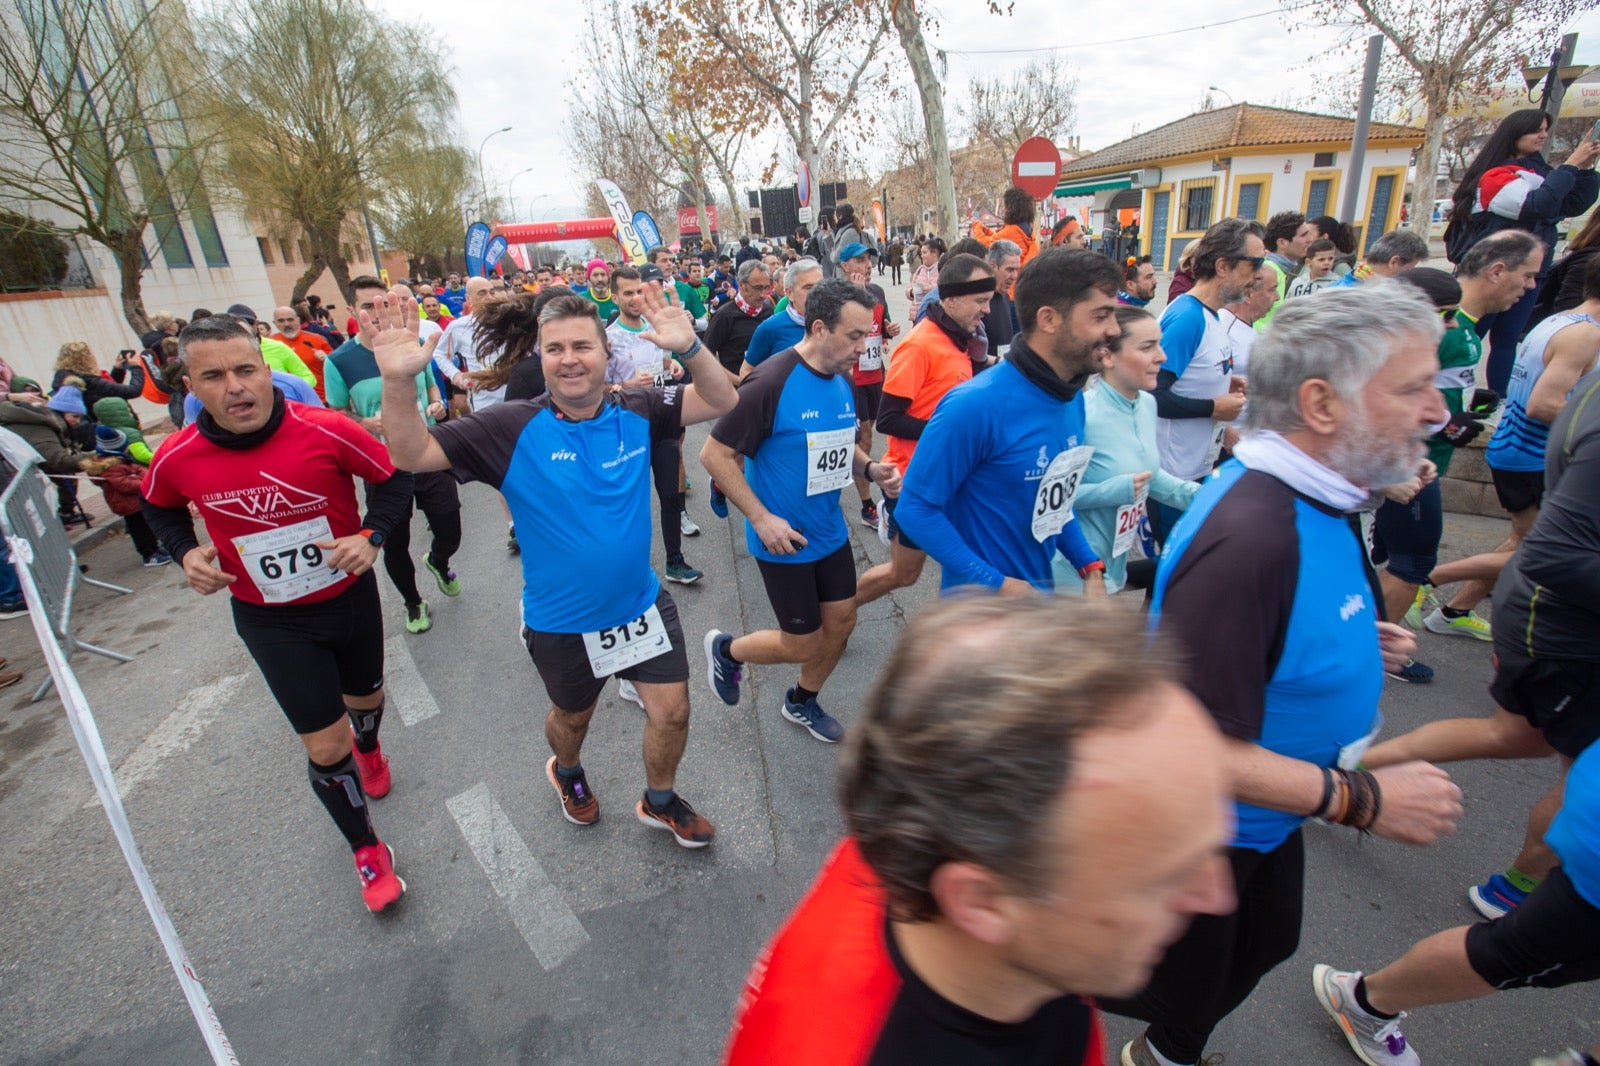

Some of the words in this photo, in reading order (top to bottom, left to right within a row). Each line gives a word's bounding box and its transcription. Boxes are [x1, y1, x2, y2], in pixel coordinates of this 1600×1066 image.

[817, 447, 848, 472] 492
[202, 492, 223, 501] CLUB
[224, 485, 279, 499] DEPORTIVO
[258, 501, 328, 520] WADIANDALUS
[259, 543, 323, 580] 679
[600, 614, 649, 650] 513
